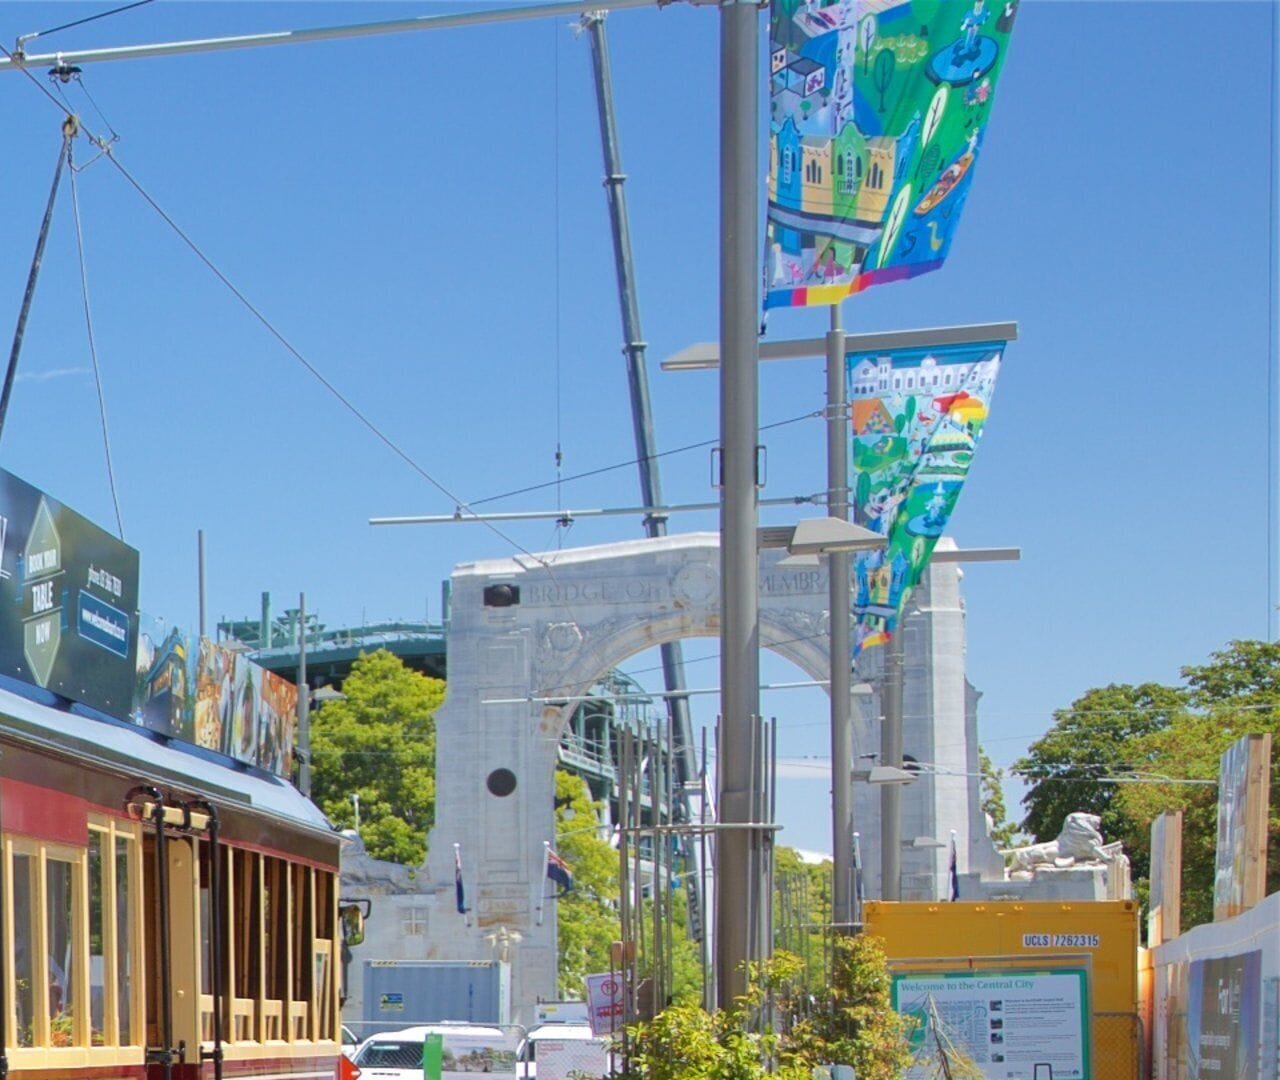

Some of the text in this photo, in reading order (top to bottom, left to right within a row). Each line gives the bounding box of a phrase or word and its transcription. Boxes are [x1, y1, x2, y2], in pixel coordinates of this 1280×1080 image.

[32, 581, 53, 613] TABLE
[529, 583, 609, 601] BRIDGE
[36, 621, 51, 645] NOW
[1024, 935, 1049, 946] UCLS
[901, 978, 1035, 992] Welcome to the Central City
